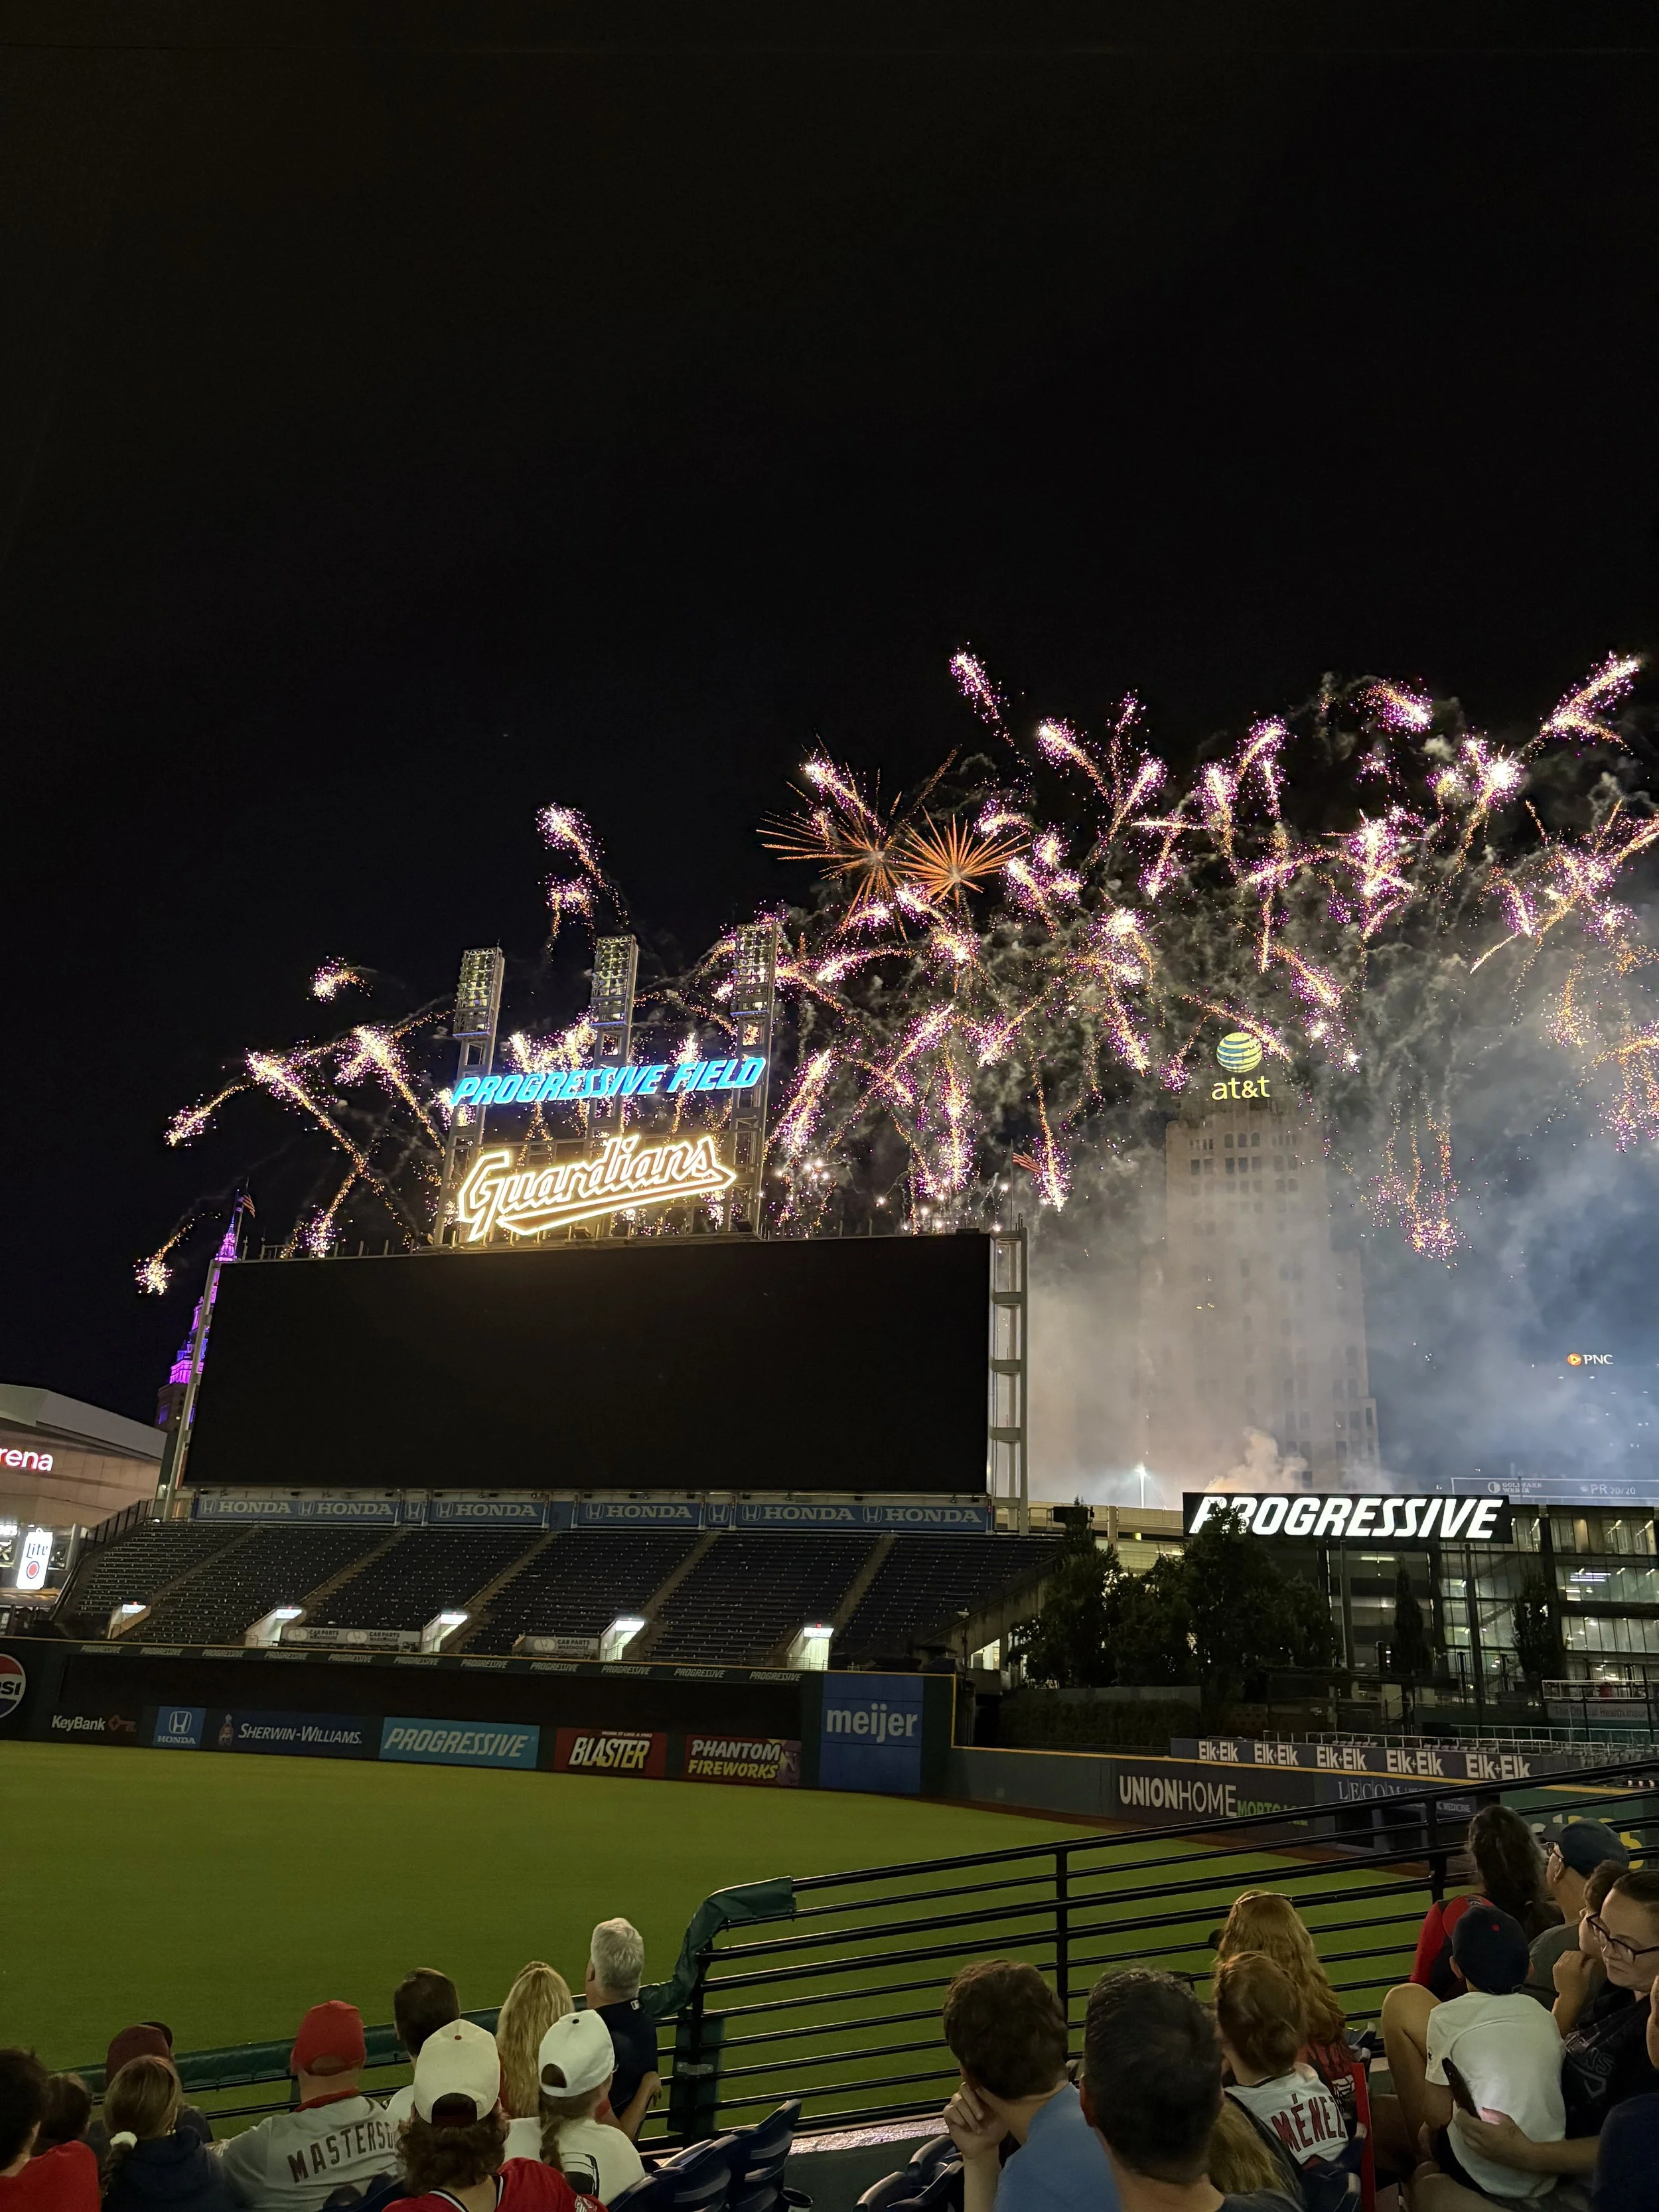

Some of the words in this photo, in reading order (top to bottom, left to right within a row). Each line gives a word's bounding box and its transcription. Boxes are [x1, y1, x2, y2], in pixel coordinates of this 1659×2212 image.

[451, 1064, 668, 1107] PROGRESSIVE
[666, 1057, 766, 1094] FIELD
[1212, 1075, 1271, 1100] at&t
[458, 1134, 737, 1243] Guardians
[1583, 1354, 1613, 1364] PNC
[1611, 1485, 1636, 1495] 20/20
[218, 1501, 293, 1514] HONDA
[317, 1503, 394, 1516] HONDA
[455, 1504, 538, 1516] HONDA
[606, 1505, 693, 1518] HONDA
[763, 1507, 855, 1520] HONDA
[885, 1509, 982, 1523] HONDA
[27, 1543, 48, 1558] Lite
[530, 1662, 579, 1672] PROGRESSIVE
[601, 1664, 652, 1675] PROGRESSIVE
[674, 1667, 726, 1678] PROGRESSIVE
[749, 1671, 802, 1682] PROGRESSIVE
[51, 1714, 106, 1732] KeyBank
[826, 1702, 918, 1743] meijer
[156, 1735, 197, 1745] HONDA
[384, 1728, 530, 1757] PROGRESSIVE
[568, 1737, 650, 1769] BLASTER
[691, 1739, 781, 1761] PHANTOM
[687, 1759, 779, 1779] FIREWORKS
